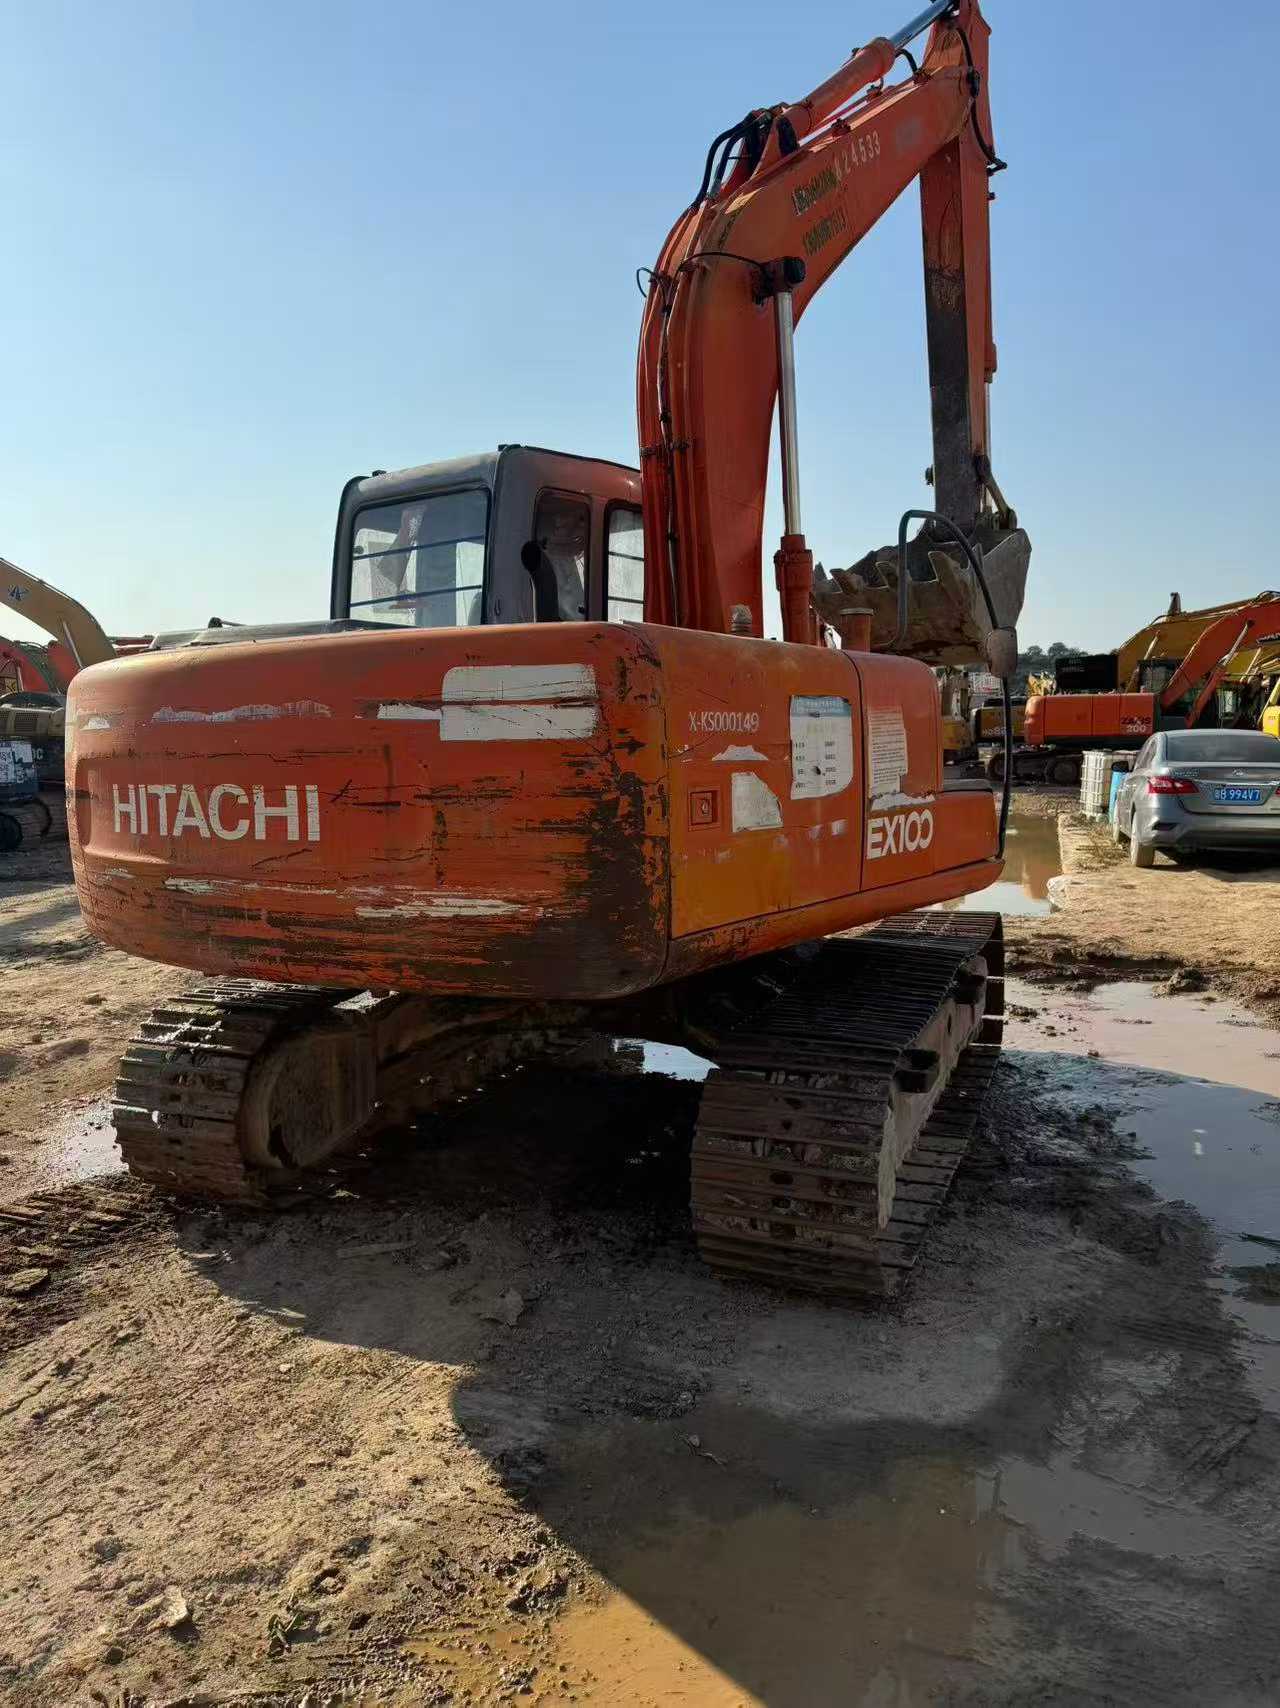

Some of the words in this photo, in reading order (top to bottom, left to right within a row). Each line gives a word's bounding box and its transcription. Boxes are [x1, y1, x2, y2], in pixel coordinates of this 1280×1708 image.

[688, 711, 760, 733] X-KS000149
[1126, 725, 1147, 733] 200
[112, 783, 321, 842] HITACHI
[866, 809, 934, 860] EX100
